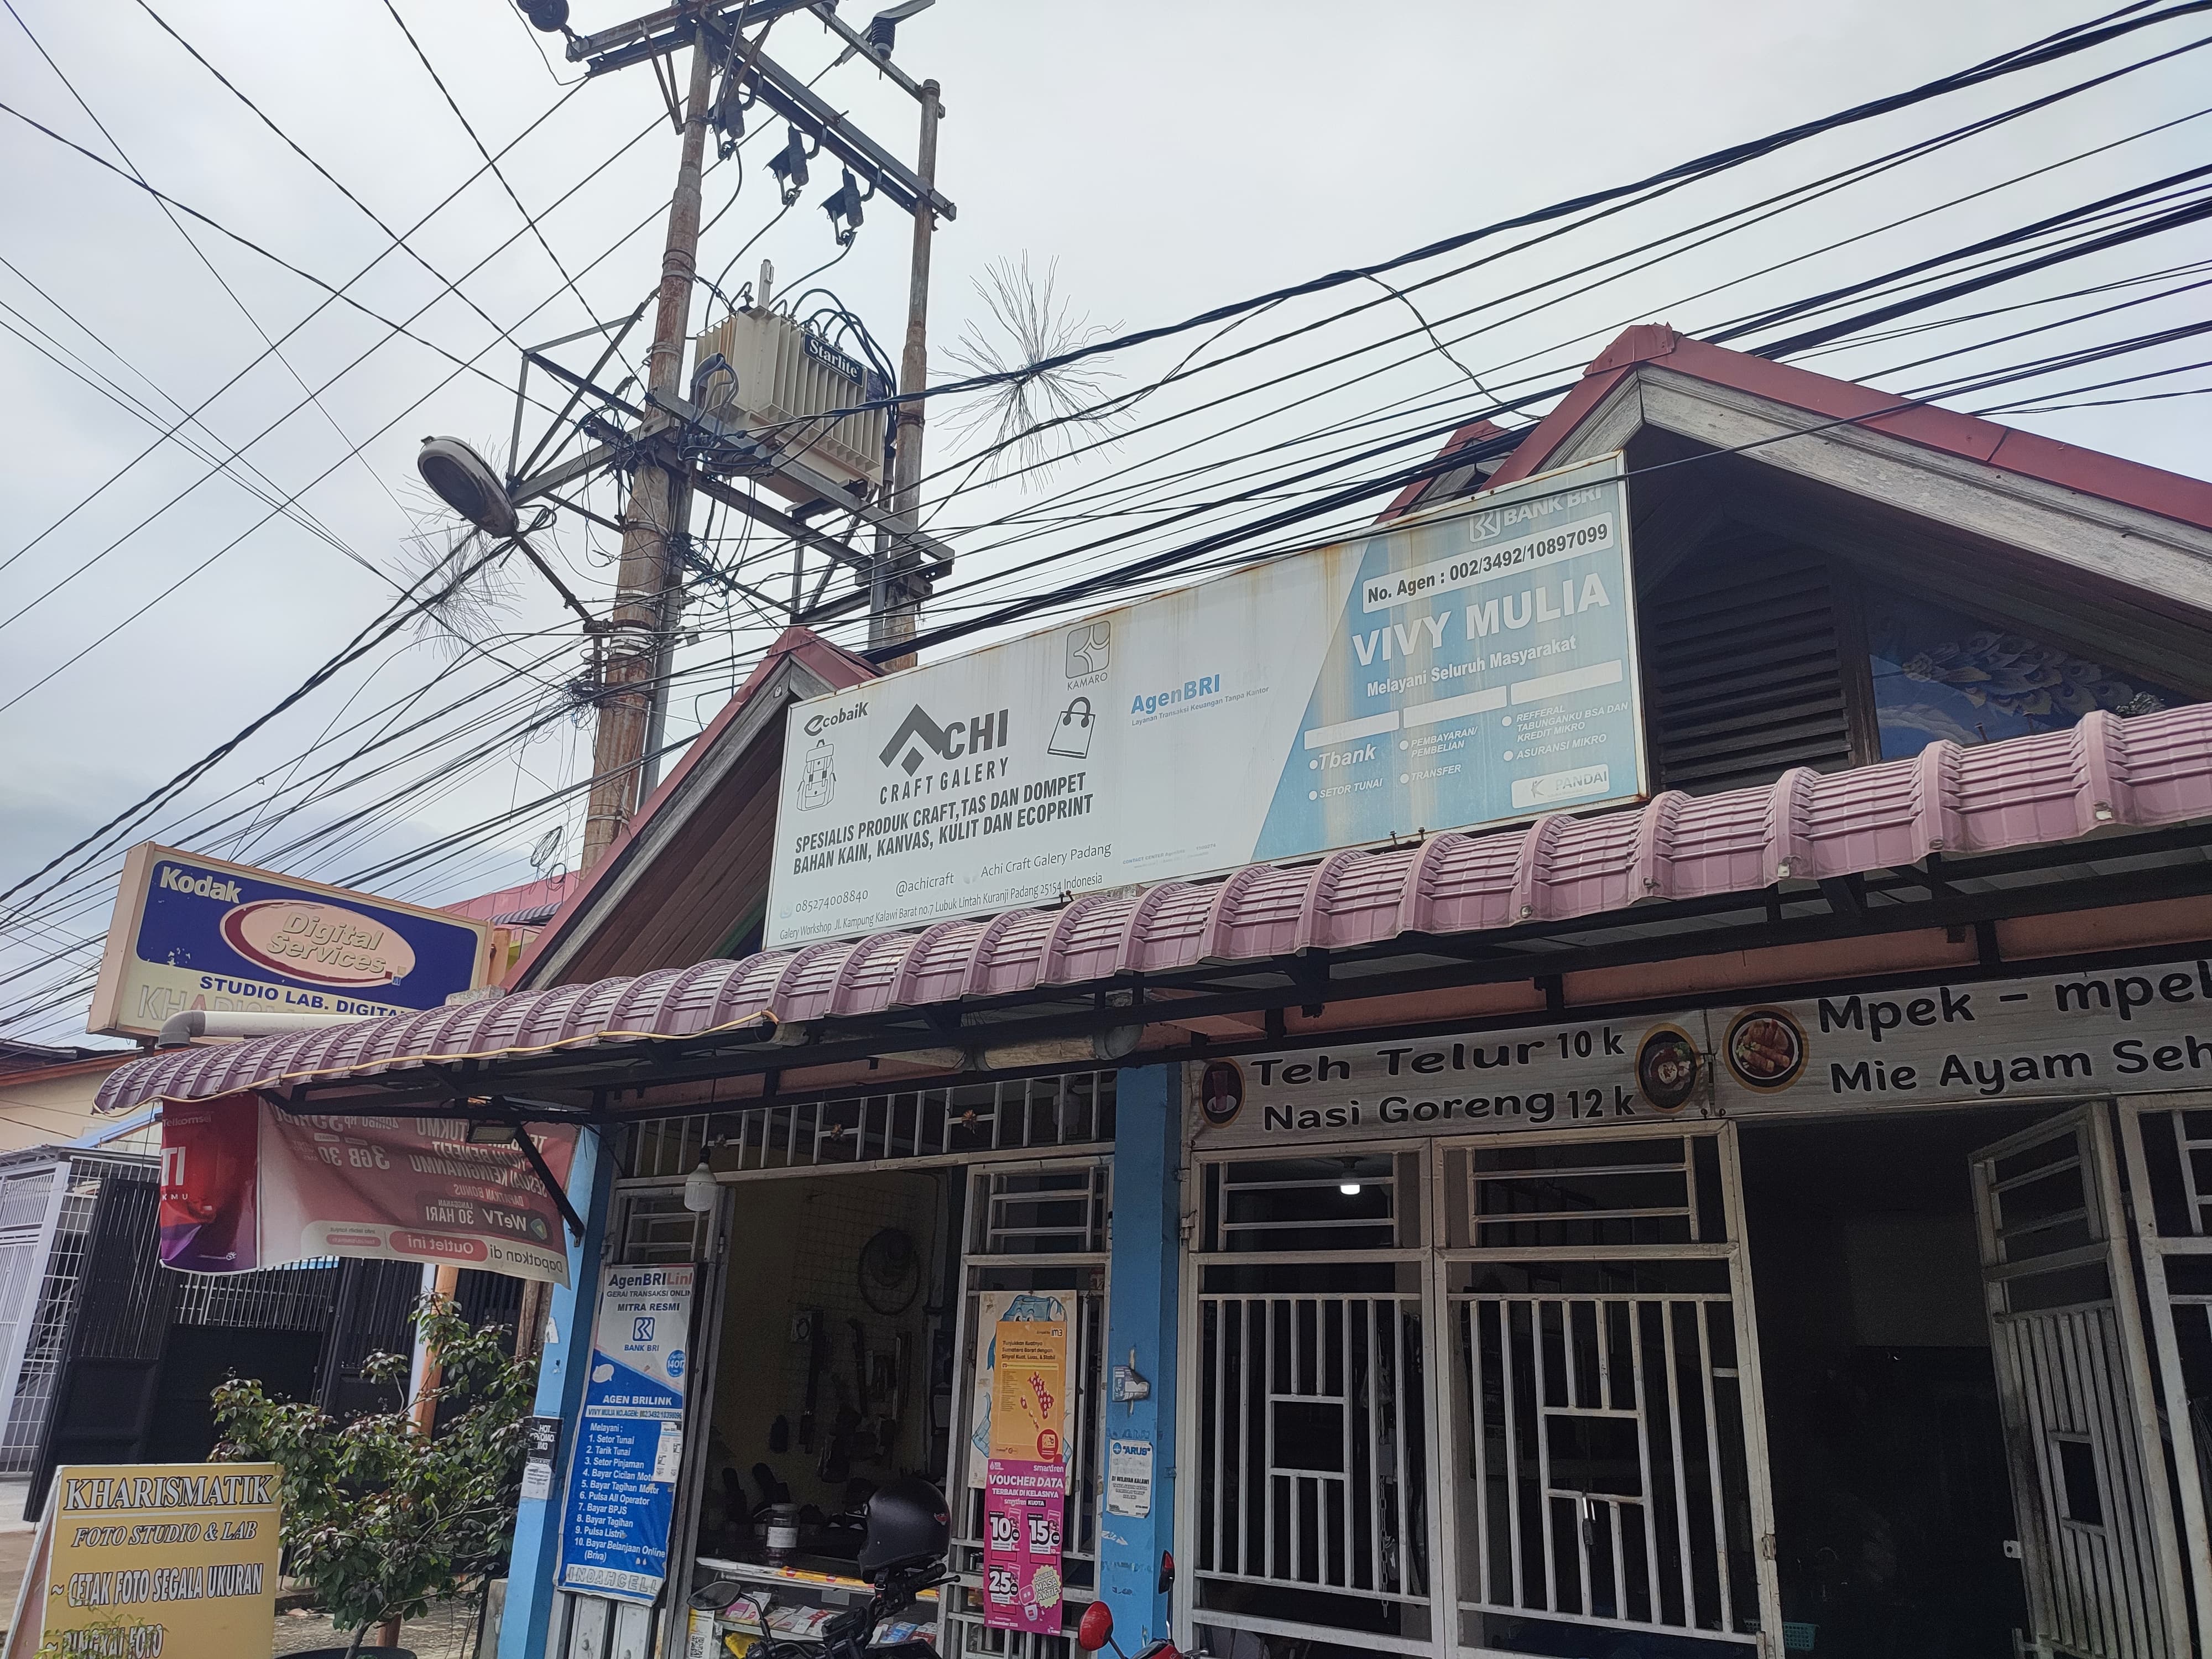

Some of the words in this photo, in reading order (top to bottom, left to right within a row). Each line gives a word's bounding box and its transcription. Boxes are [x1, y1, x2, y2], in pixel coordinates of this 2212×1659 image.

[809, 338, 858, 377] Starlite
[1504, 495, 1564, 526] BANK
[1567, 487, 1601, 508] BRI
[1368, 587, 1392, 603] No.
[1397, 573, 1435, 596] Agen
[1449, 523, 1608, 581] 002/3492/10897099
[1351, 610, 1452, 667] VIVY
[1466, 572, 1610, 640] MULIA
[1366, 670, 1427, 697] Melayani
[1431, 657, 1486, 682] Seluruh
[1489, 634, 1577, 669] Masyarakat
[1067, 671, 1108, 691] KAMARO
[1130, 674, 1220, 715] AgenBRI
[1131, 714, 1157, 726] Layanan
[1159, 706, 1190, 719] Transaksi
[1190, 697, 1223, 712] Keuangan
[1224, 692, 1245, 703] Tanpa
[1246, 686, 1270, 698] Kantor
[1516, 705, 1566, 723] REFFERAL
[1517, 711, 1582, 732] TABUNGANKU
[1584, 706, 1605, 719] BSA
[1606, 701, 1629, 713] DAN
[878, 703, 1009, 777] ACHI
[1411, 726, 1478, 748] PEMBAYARAN/
[1517, 728, 1552, 743] KREDIT
[1553, 721, 1585, 735] MIKRO
[1318, 743, 1377, 771] Tbank
[1411, 740, 1465, 758] PEMBELIAN
[1516, 741, 1570, 760] ASURANSI
[1571, 733, 1607, 748] MIKRO
[880, 774, 933, 805] CRAFT
[940, 757, 1009, 791] GALERY
[1411, 764, 1462, 781] TRANSFER
[1319, 784, 1351, 799] SETOR
[1354, 778, 1384, 792] TUNAI
[795, 824, 854, 854] SPESIALIS
[857, 812, 910, 839] PRODUK
[990, 787, 1019, 811] DAN
[1023, 771, 1086, 804] DOMPET
[793, 849, 834, 875] BAHAN
[838, 842, 872, 863] KAIN,
[877, 829, 933, 857] KANVAS,
[939, 818, 979, 844] KULIT
[983, 811, 1013, 836] DAN
[1017, 793, 1093, 828] ECOPRINT
[1123, 857, 1144, 865] CONTACT
[159, 865, 242, 904] Kodak
[795, 889, 869, 914] 085274008840
[896, 872, 954, 897] @achicraft
[980, 863, 1003, 878] Achi
[1005, 858, 1031, 873] Craft
[1034, 852, 1068, 868] Galery
[1070, 843, 1112, 860] Padang
[780, 929, 799, 940] Galery
[801, 922, 832, 937] Workshop
[843, 914, 874, 929] Kampung
[875, 909, 898, 922] Kalawi
[899, 907, 917, 919] Barat
[935, 897, 957, 912] Lubuk
[959, 894, 981, 908] Lintah
[983, 889, 1009, 904] Kuranji
[1010, 885, 1039, 900] Padang
[1040, 881, 1062, 895] 25154
[1063, 872, 1103, 890] Indonesia
[283, 911, 385, 951] Digital
[266, 932, 387, 973] Services
[199, 975, 279, 1000] STUDIO
[285, 990, 329, 1010] LAB.
[1817, 987, 1975, 1042] Mpek
[1249, 1055, 1351, 1087] Teh
[1376, 1031, 1545, 1077] Telur
[1556, 1031, 1592, 1061] 10
[1830, 1058, 1917, 1094] Mie
[1938, 1051, 2093, 1095] Ayam
[162, 1113, 212, 1127] Telkomsel
[1264, 1098, 1361, 1132] Nasi
[1377, 1088, 1556, 1124] Goreng
[1567, 1088, 1604, 1120] 12
[617, 1303, 646, 1311] MITRA
[649, 1302, 681, 1311] RESMI
[602, 1395, 629, 1404] AGEN
[632, 1396, 672, 1406] BRILINK
[539, 1424, 551, 1433] HOT
[597, 1434, 615, 1443] Setor
[615, 1435, 635, 1444] Tunai
[596, 1446, 612, 1455] Tarik
[613, 1447, 631, 1456] Tunai
[591, 1468, 612, 1479] Bayar
[613, 1470, 635, 1480] Cicilan
[593, 1457, 612, 1466] Setor
[613, 1458, 644, 1469] Pinjaman
[1033, 1464, 1064, 1473] smartfren
[63, 1474, 279, 1511] KHARISMATIK
[590, 1480, 611, 1491] Bayar
[612, 1481, 637, 1493] Tagihan
[989, 1474, 1036, 1487] VOUCHER
[1036, 1477, 1064, 1489] DATA
[588, 1491, 608, 1501] Pulsa
[619, 1494, 650, 1505] Operator
[992, 1488, 1019, 1496] TERBAIK
[1025, 1490, 1059, 1499] KELASNYA
[587, 1503, 607, 1514] Bayar
[608, 1505, 628, 1515] BPJS
[584, 1526, 603, 1536] Pulsa
[585, 1515, 606, 1526] Bayar
[607, 1516, 634, 1527] Tagihan
[990, 1516, 1011, 1539] 10
[1029, 1520, 1049, 1542] 15
[71, 1524, 128, 1548] FOTO
[128, 1522, 201, 1545] STUDIO
[221, 1520, 259, 1541] LAB
[584, 1550, 607, 1562] (Briva)
[586, 1538, 607, 1548] Bayar
[607, 1540, 640, 1554] Belanjaan
[641, 1546, 666, 1558] Online
[67, 1572, 114, 1608] CETAK
[113, 1569, 150, 1606] FOTO
[153, 1566, 204, 1602] SEGALA
[207, 1563, 264, 1599] UKURAN
[988, 1571, 1012, 1593] 25
[1034, 1569, 1054, 1582] DOUBLE
[1035, 1577, 1058, 1593] MASA
[128, 1623, 164, 1659] FOTO
